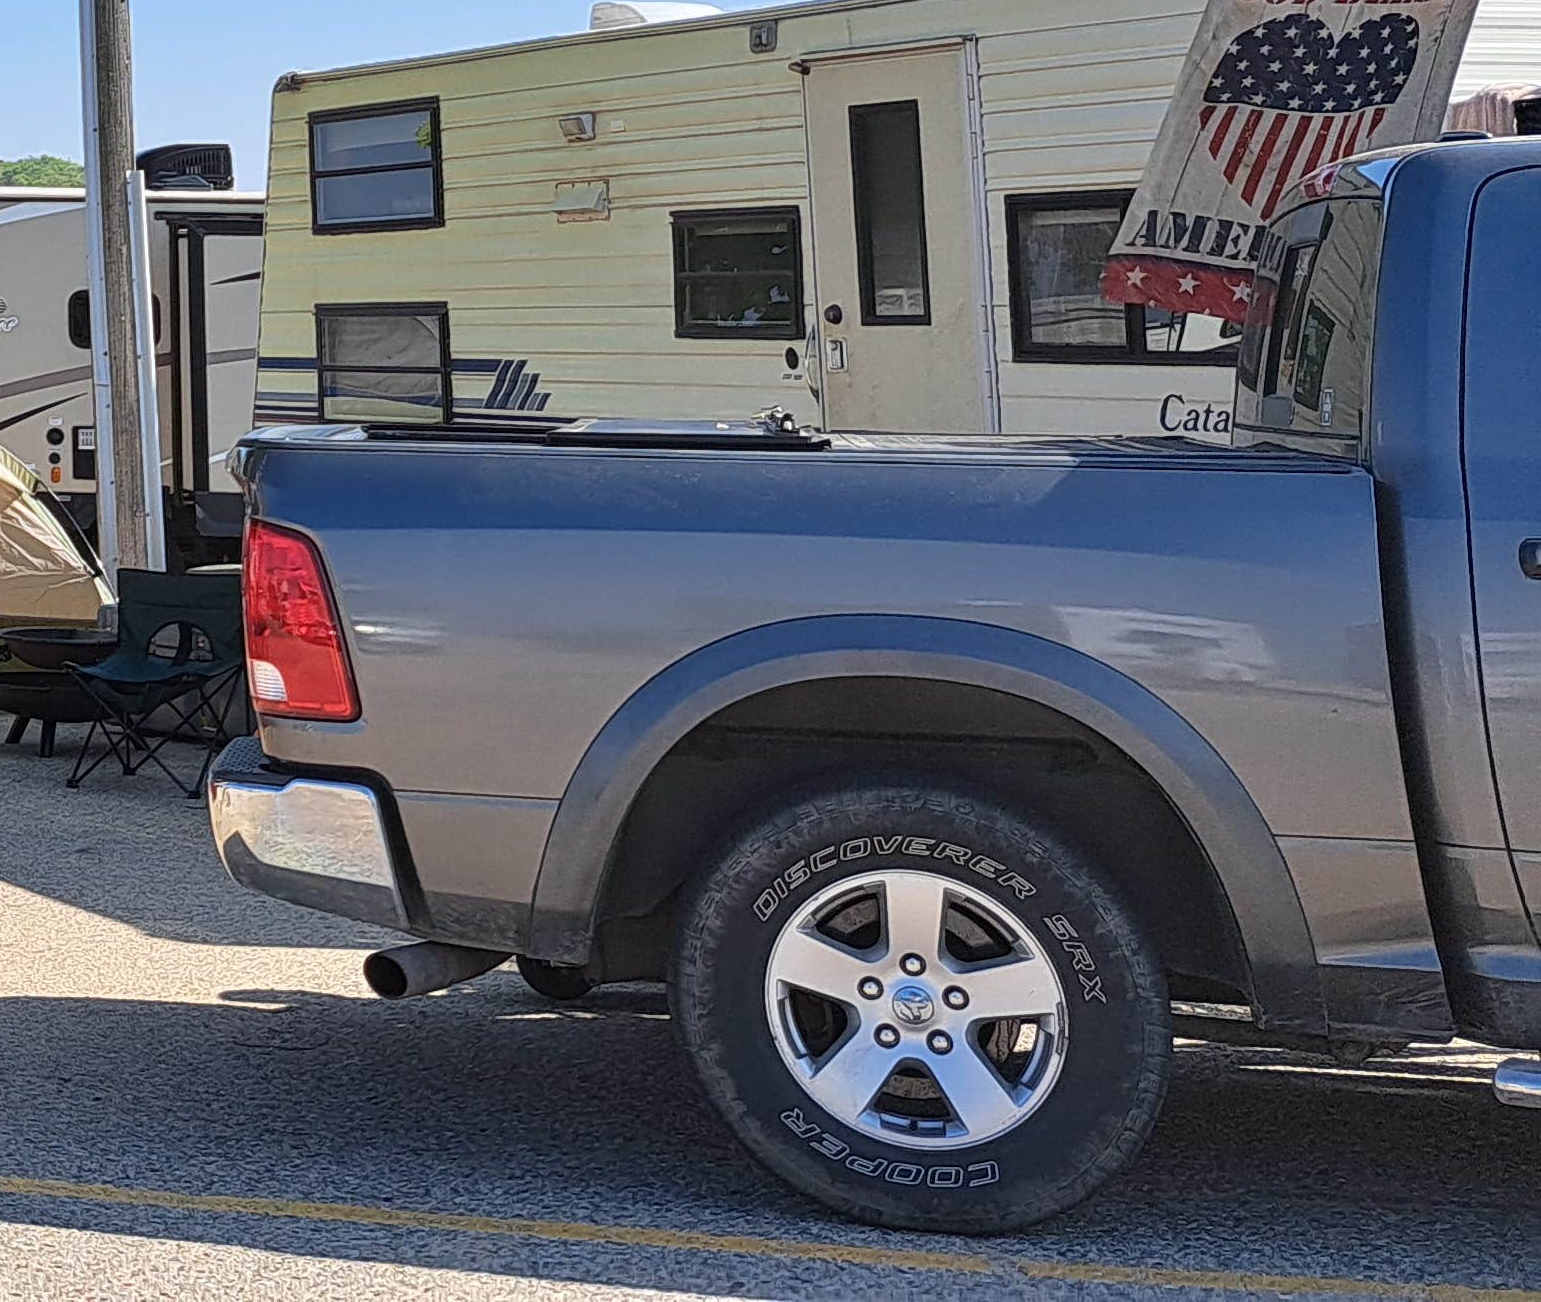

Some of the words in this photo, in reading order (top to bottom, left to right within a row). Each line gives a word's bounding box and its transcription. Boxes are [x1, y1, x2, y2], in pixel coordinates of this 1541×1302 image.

[751, 834, 1037, 924] DISCOVERER
[1044, 913, 1109, 1005] SRX
[779, 1106, 1002, 1189] COOPER
